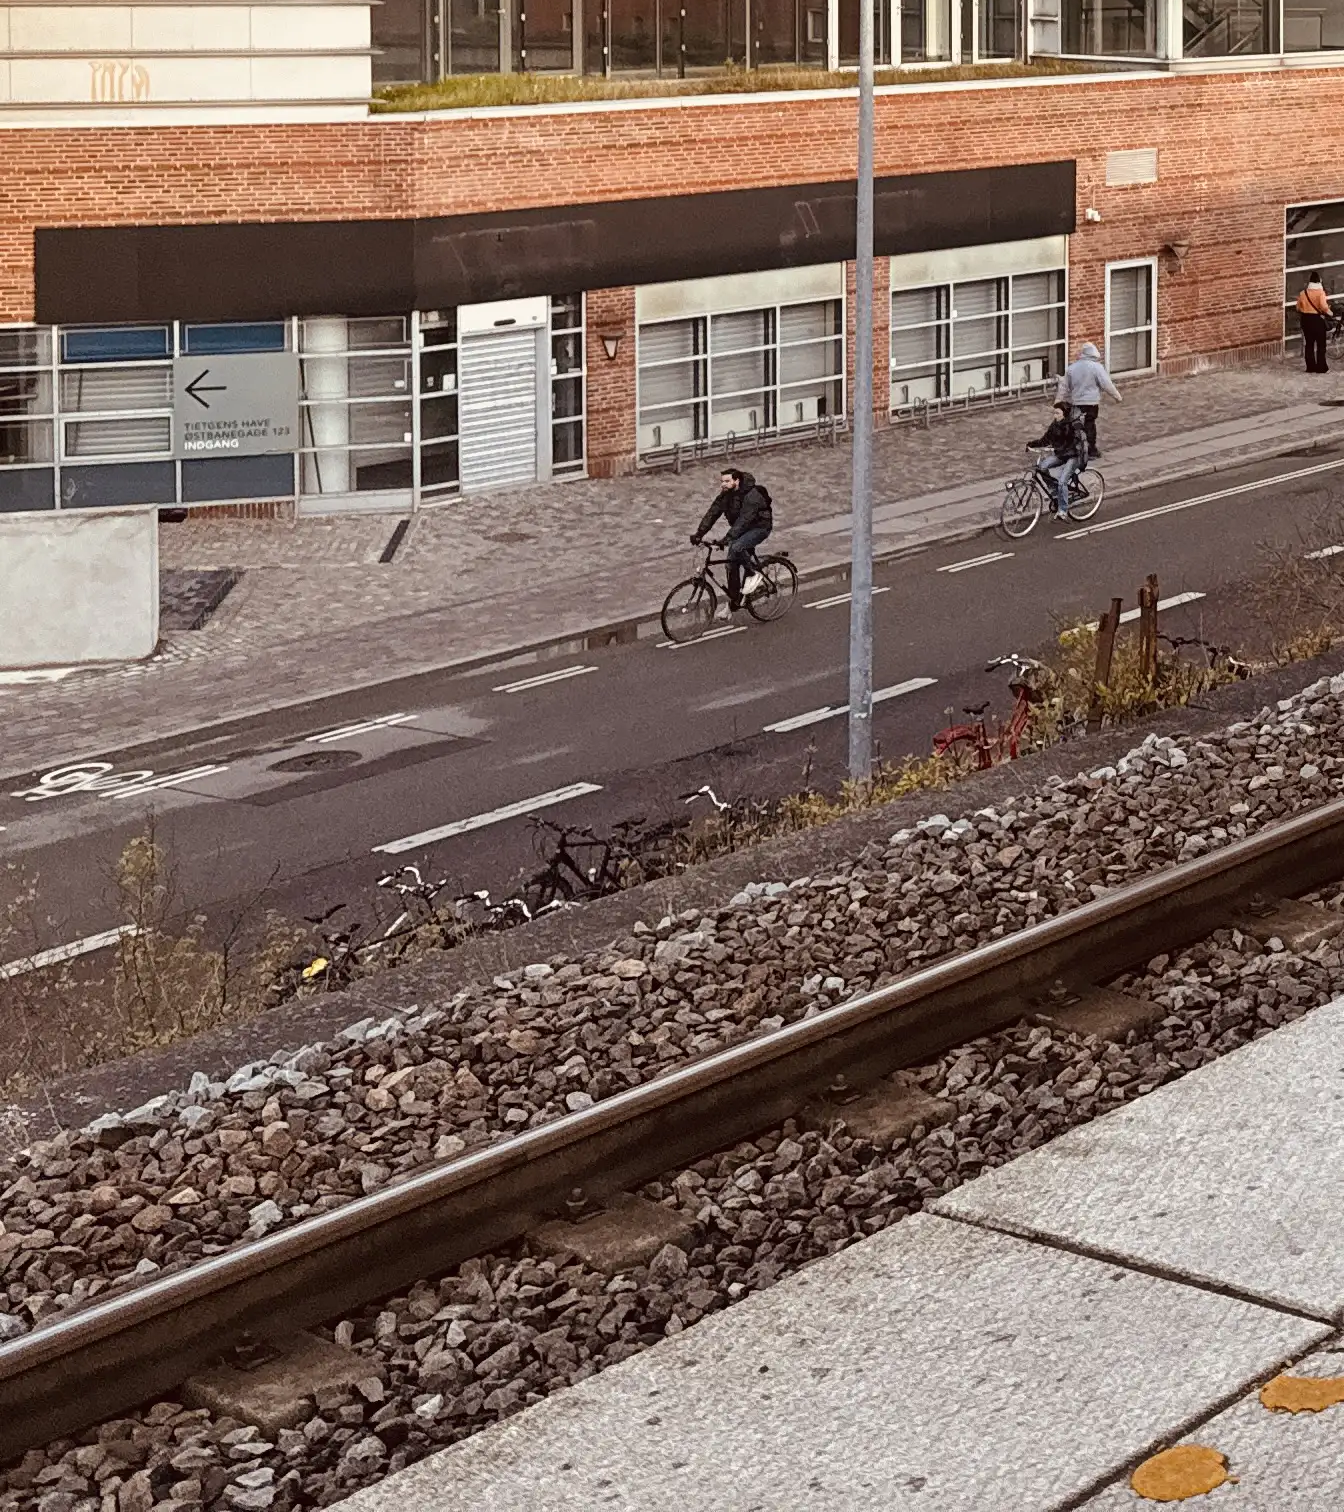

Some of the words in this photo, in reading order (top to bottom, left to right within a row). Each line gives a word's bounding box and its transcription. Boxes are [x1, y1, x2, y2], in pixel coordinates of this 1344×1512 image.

[184, 419, 238, 431] TIETGENS
[241, 417, 271, 427] HAVE
[184, 438, 239, 450] INDGANG
